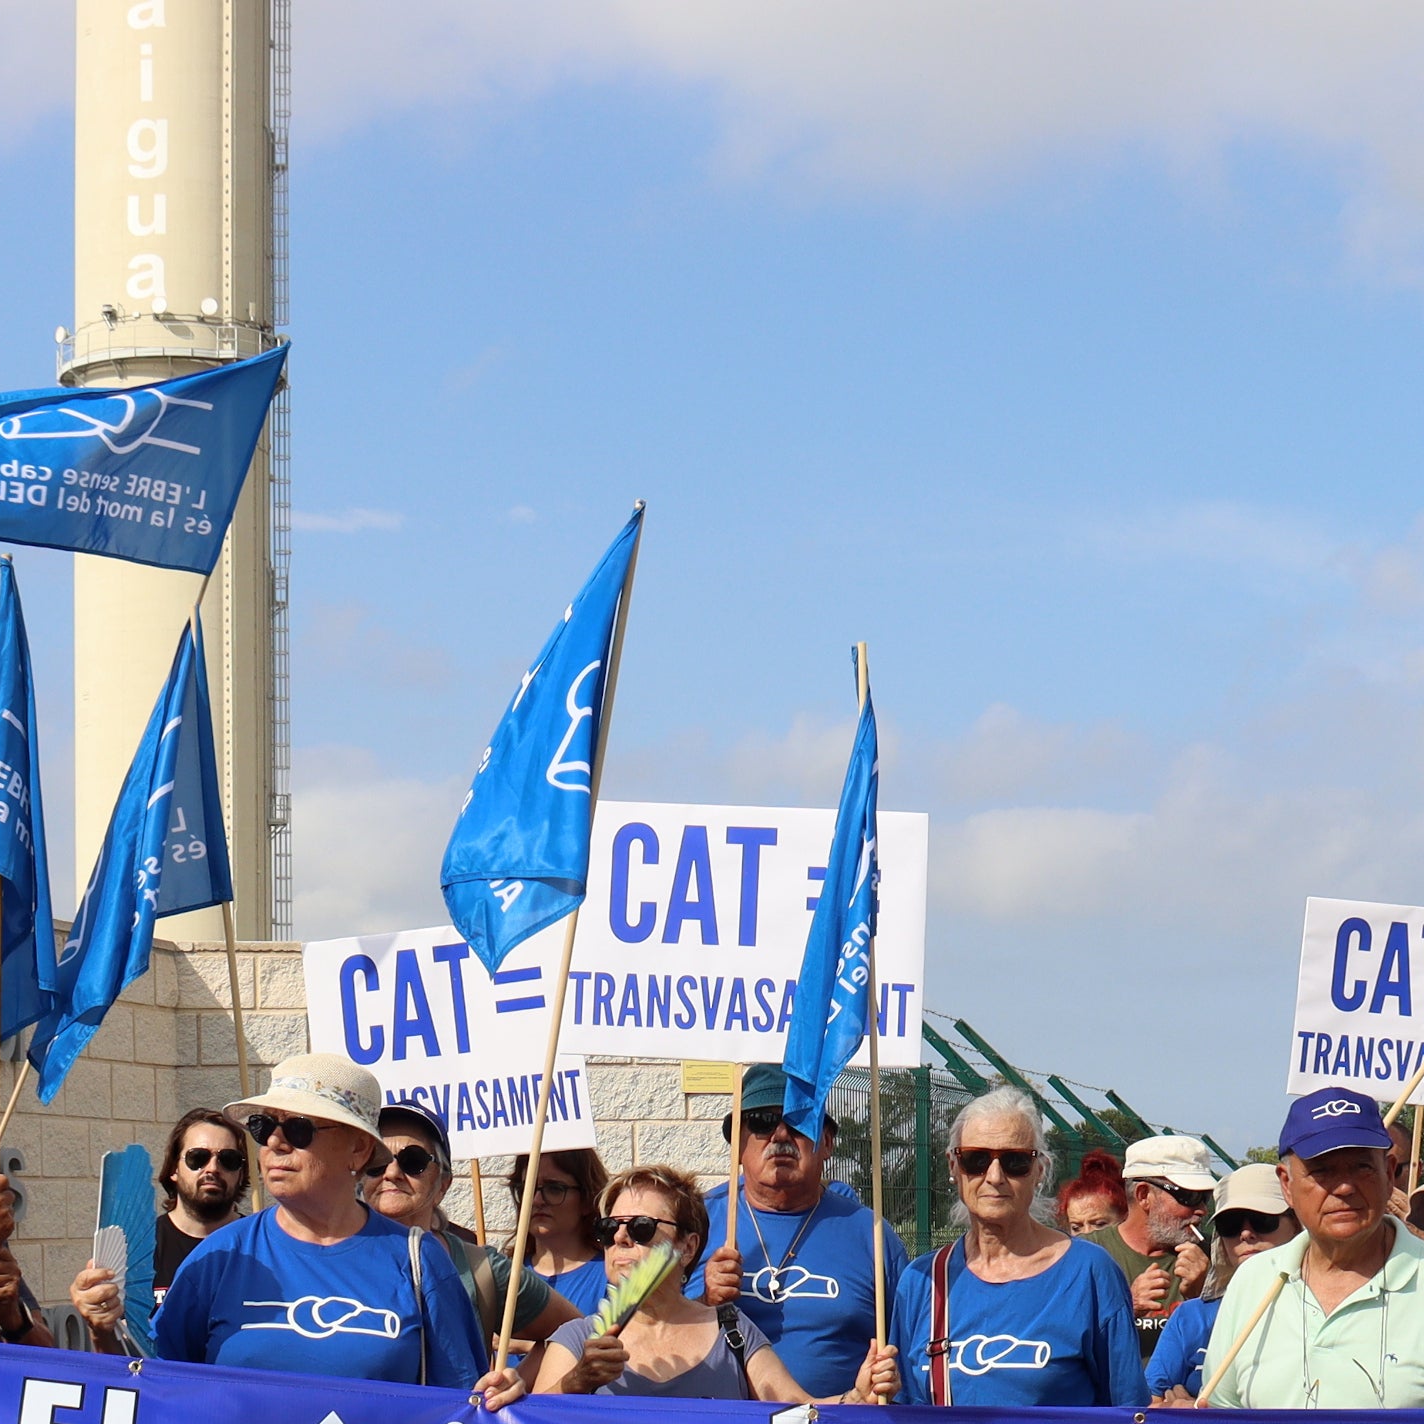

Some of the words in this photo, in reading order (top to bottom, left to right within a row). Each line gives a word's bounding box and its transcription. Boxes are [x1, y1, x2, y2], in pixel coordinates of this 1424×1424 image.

[609, 822, 778, 947] CAT
[339, 942, 471, 1066] CAT
[569, 971, 915, 1038] TRANSVASANT
